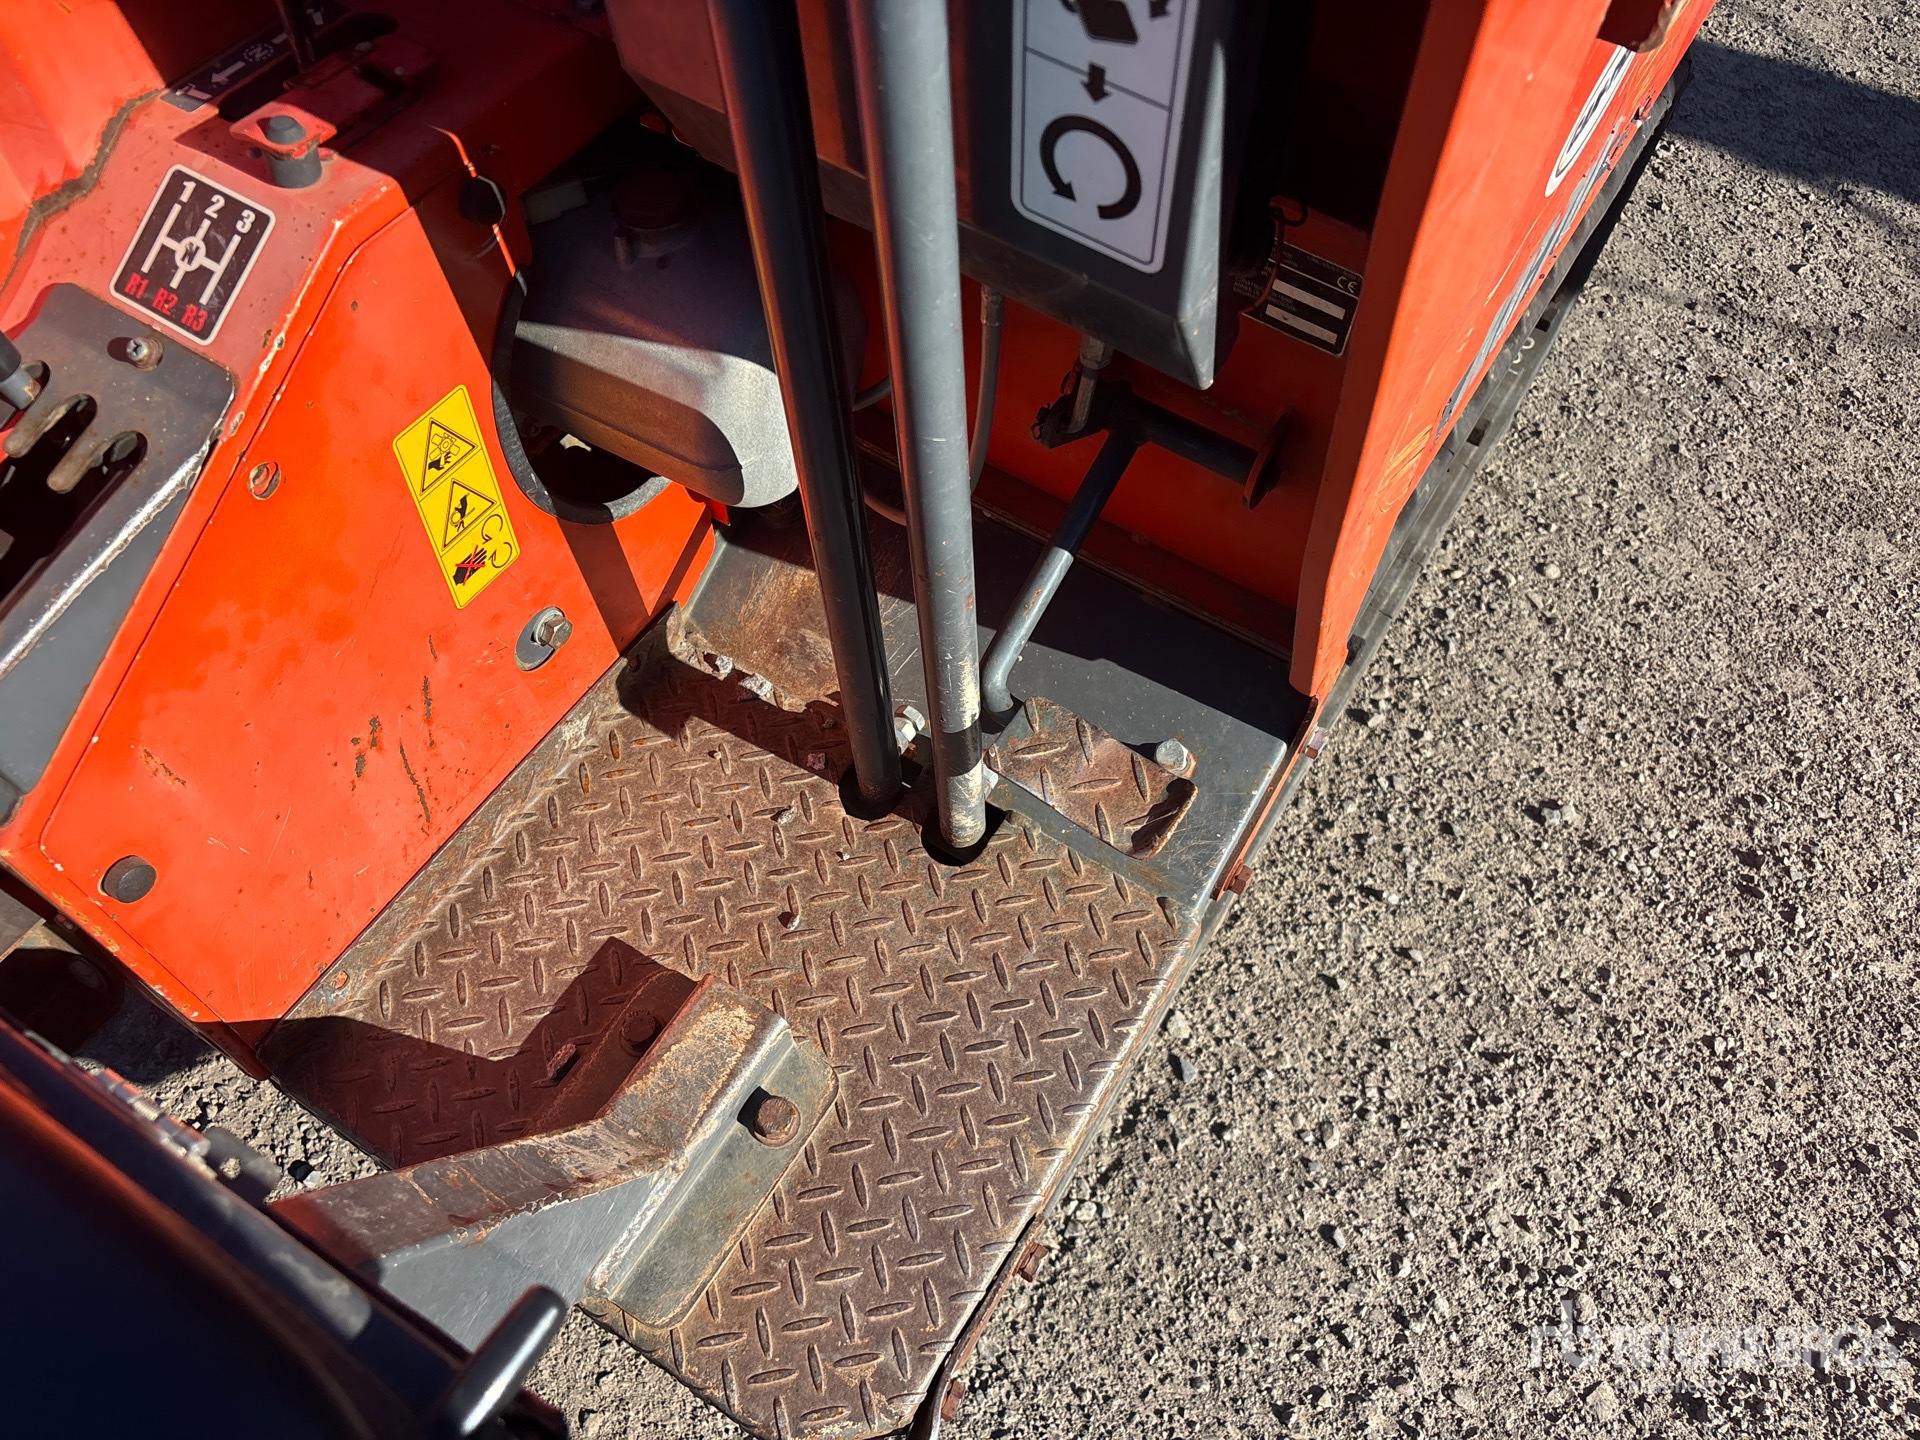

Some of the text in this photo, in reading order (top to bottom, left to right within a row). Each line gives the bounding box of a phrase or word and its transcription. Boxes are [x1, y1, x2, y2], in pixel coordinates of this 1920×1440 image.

[180, 181, 256, 234] 1 2 3
[181, 242, 200, 266] N
[124, 273, 208, 332] R1 R2 R3
